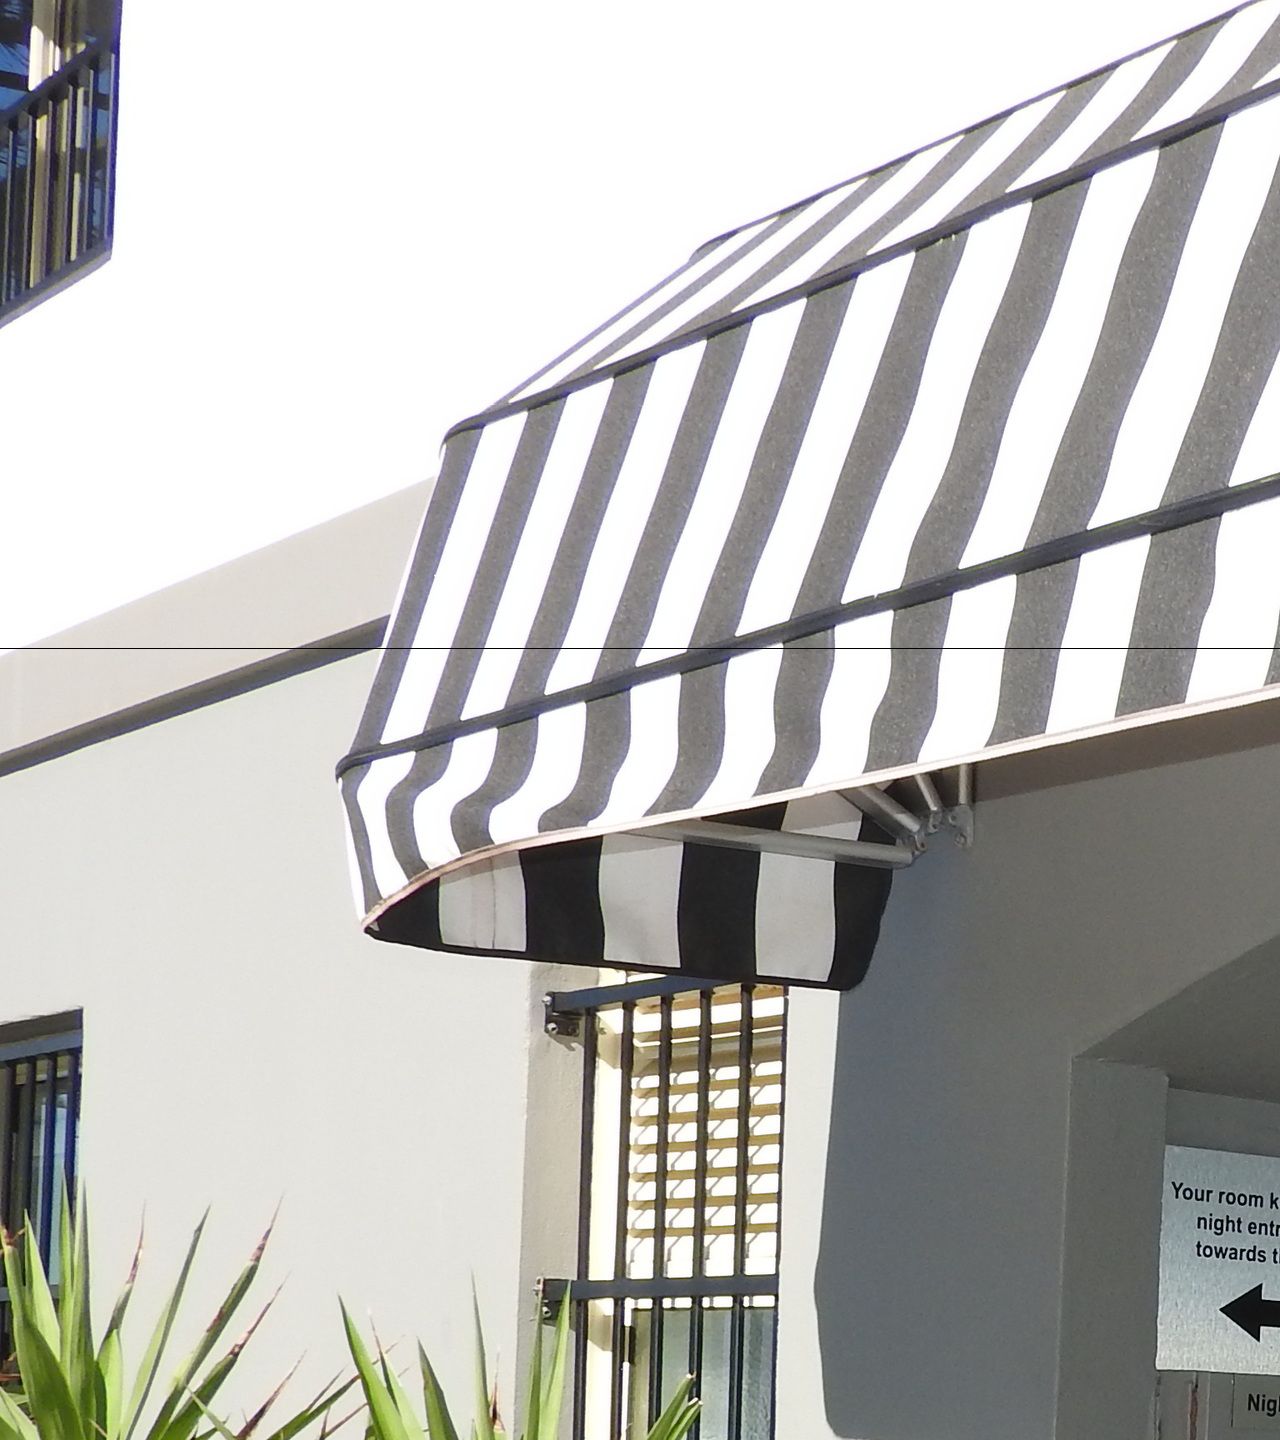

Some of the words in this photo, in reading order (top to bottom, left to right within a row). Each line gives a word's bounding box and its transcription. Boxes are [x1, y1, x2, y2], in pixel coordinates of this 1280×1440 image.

[1172, 1181, 1213, 1203] Your
[1218, 1191, 1264, 1208] room
[1196, 1214, 1243, 1238] night
[1195, 1240, 1267, 1263] towards
